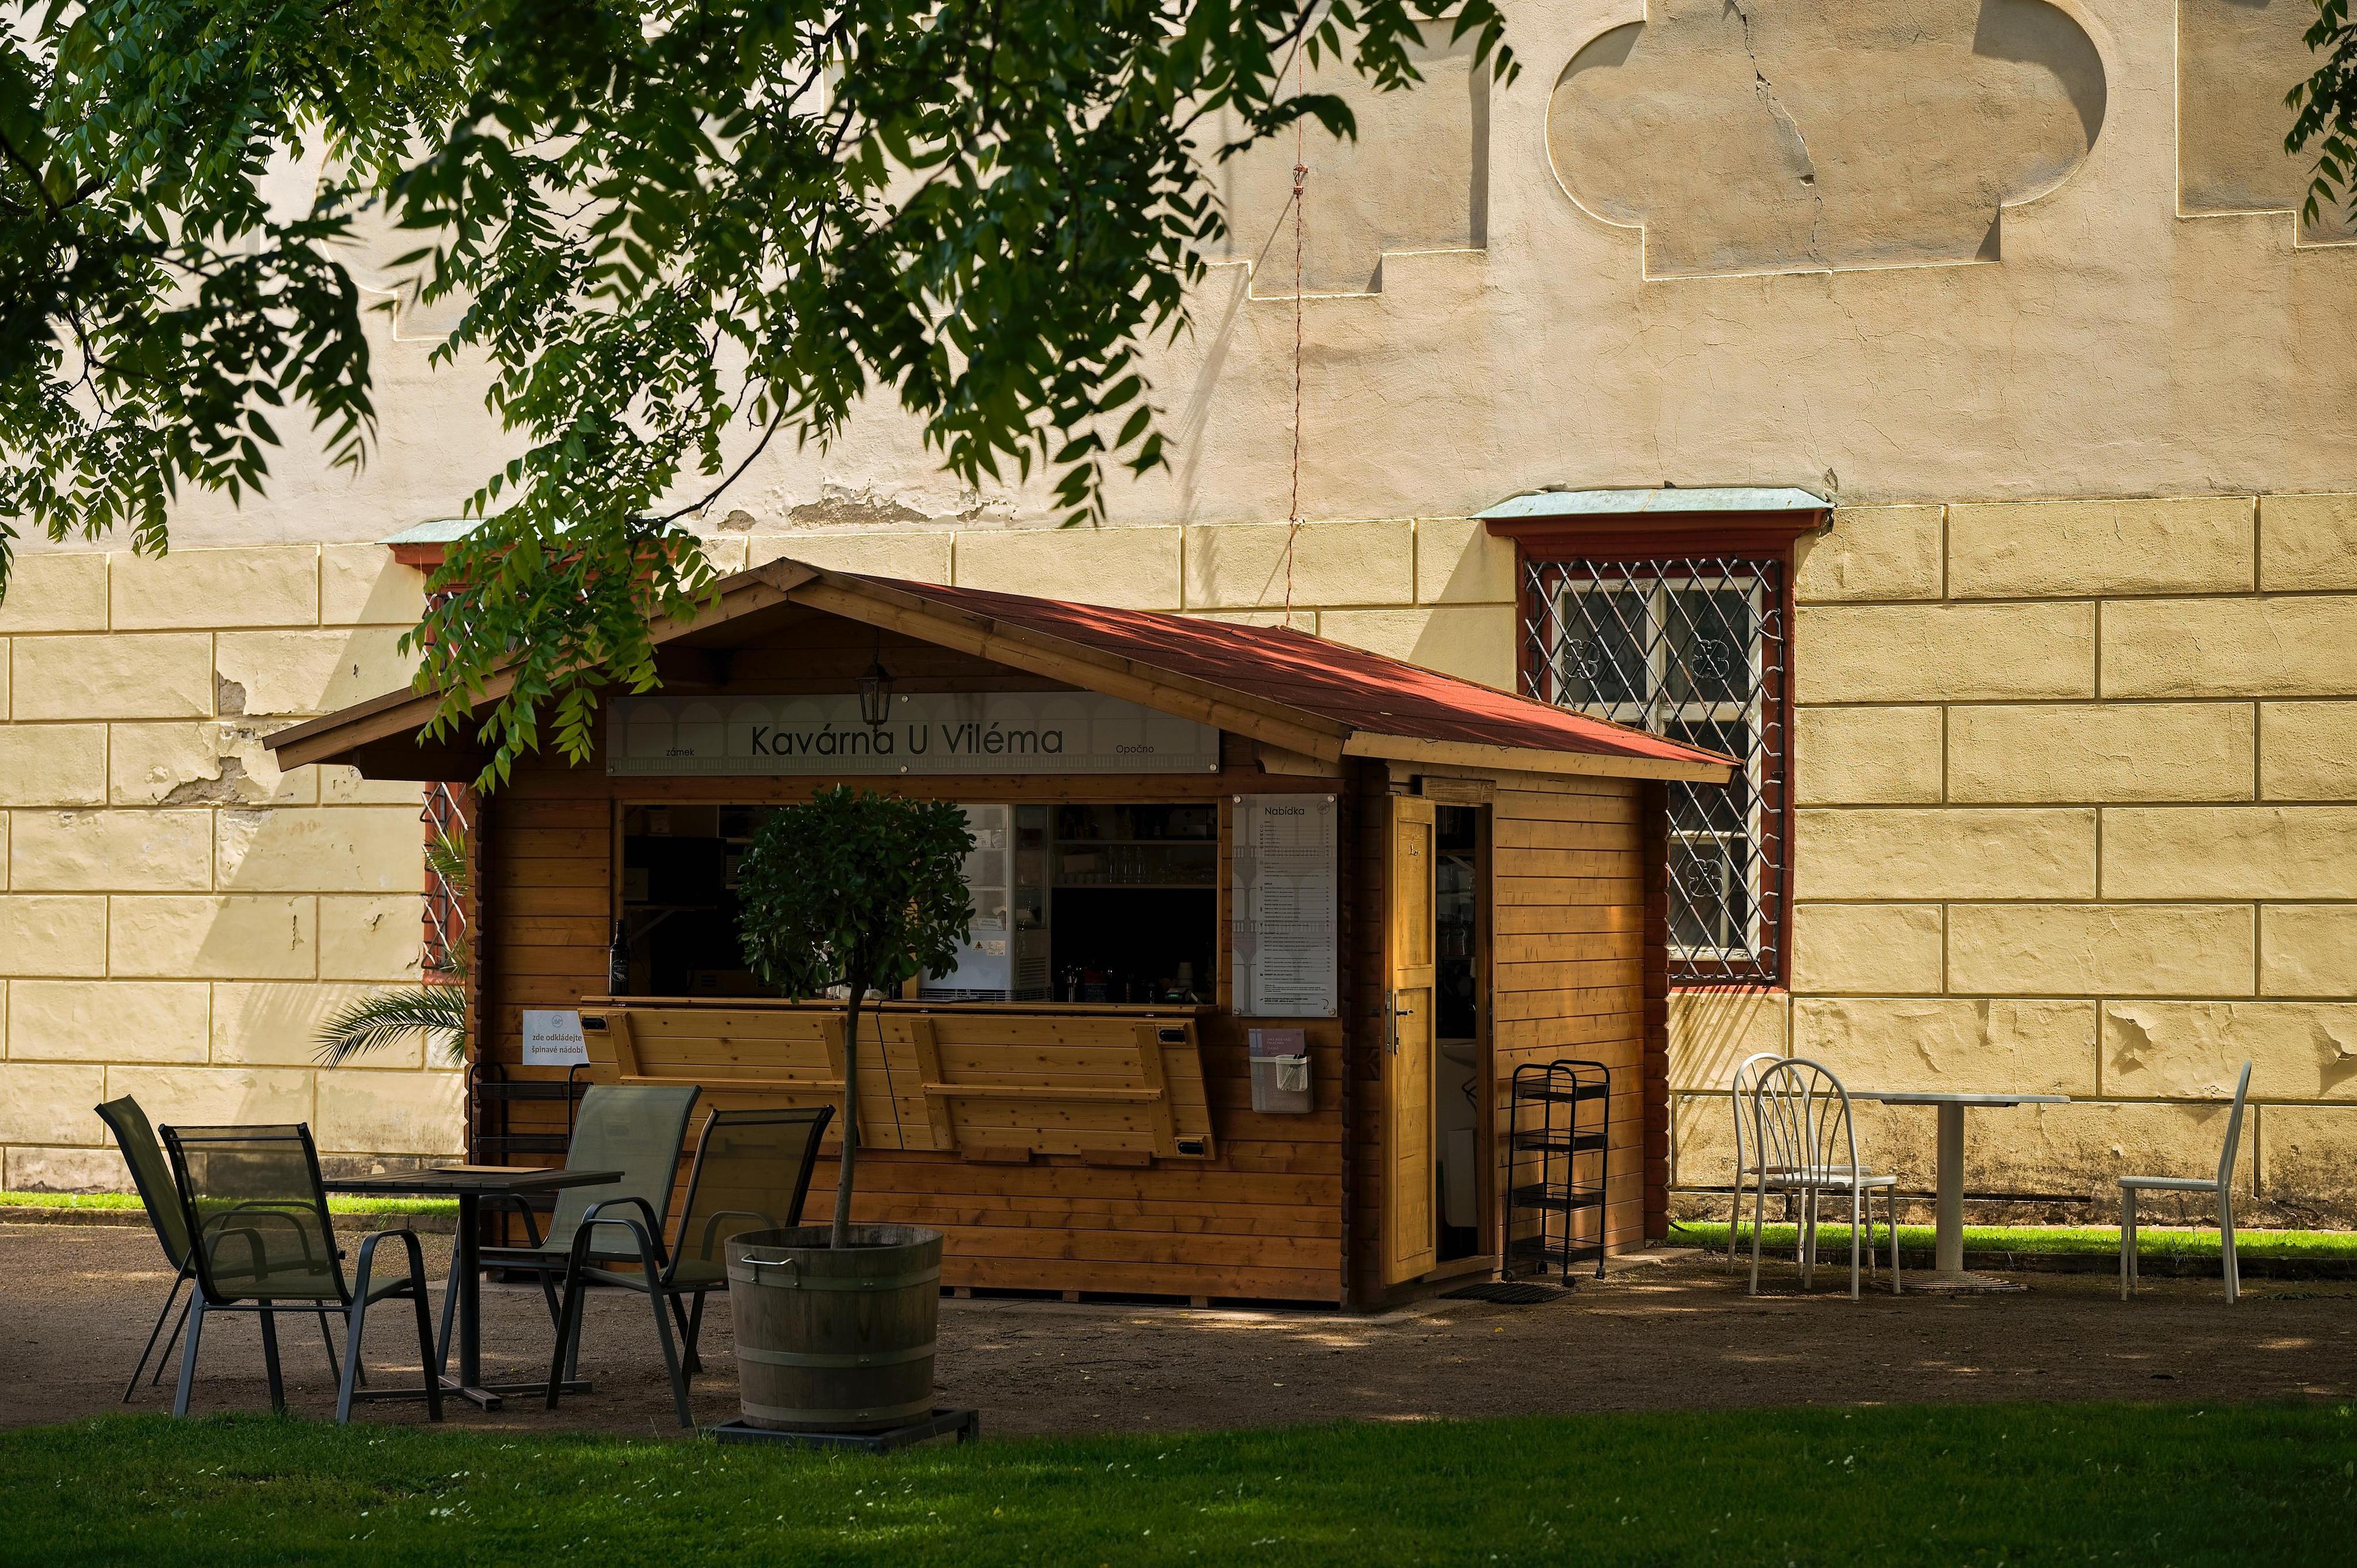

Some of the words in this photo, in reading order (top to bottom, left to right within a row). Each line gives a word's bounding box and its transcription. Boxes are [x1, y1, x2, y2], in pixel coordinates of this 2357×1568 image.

[752, 723, 894, 755] Kavárna
[909, 725, 929, 755] U
[941, 722, 1062, 754] Viléma
[666, 747, 695, 757] zámek
[1116, 744, 1154, 755] Opočno
[1265, 806, 1305, 816] Nabídka
[546, 1034, 582, 1042] odkládejte
[532, 1045, 558, 1054] špinavé
[559, 1045, 583, 1054] nádobí
